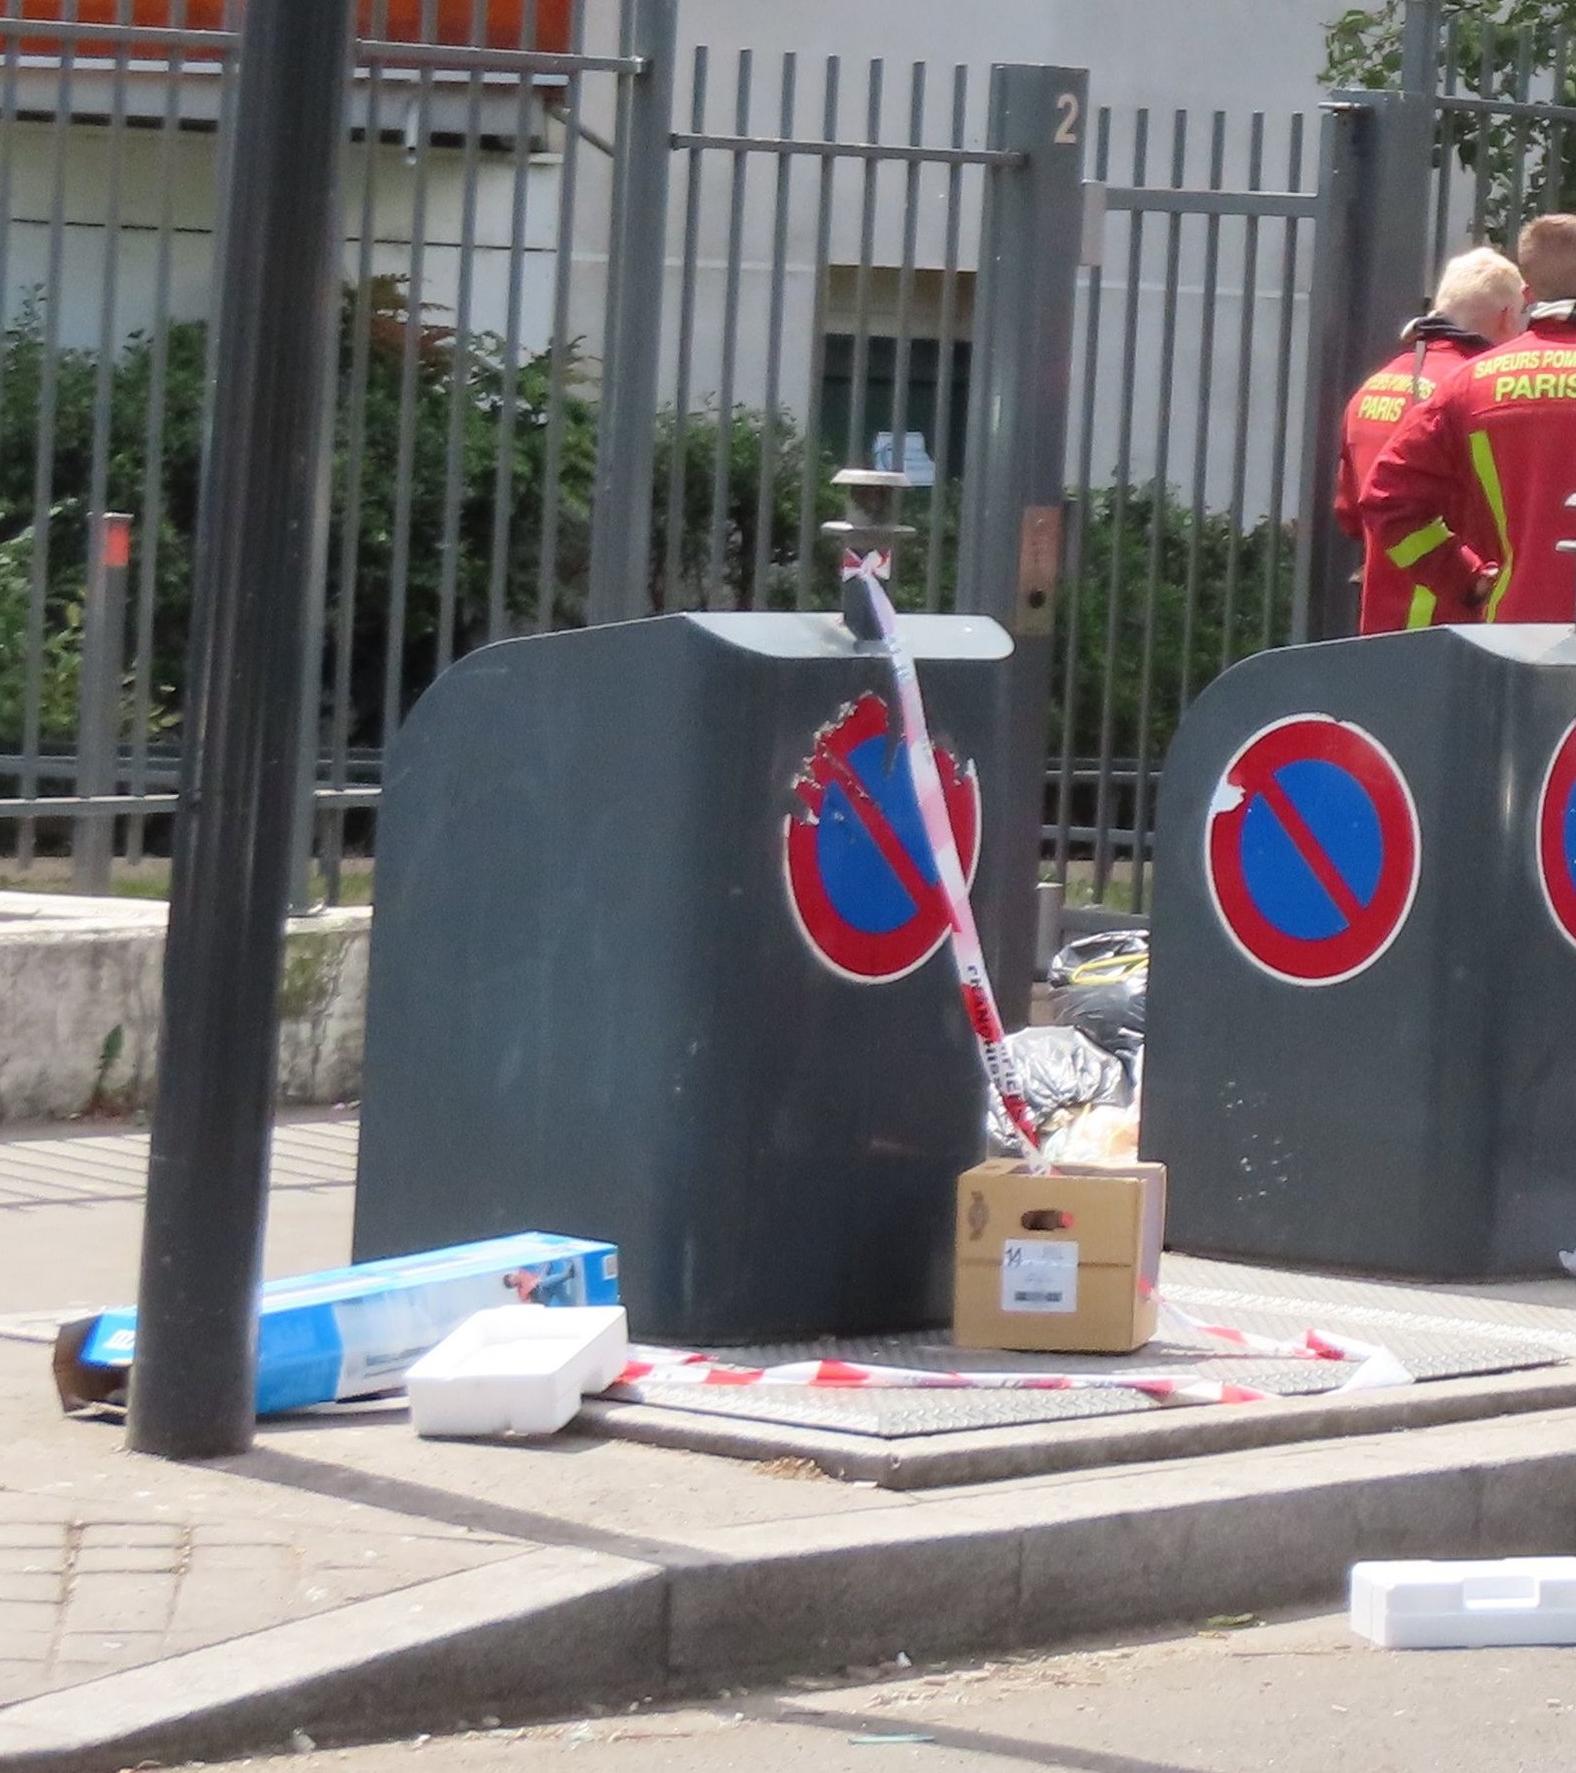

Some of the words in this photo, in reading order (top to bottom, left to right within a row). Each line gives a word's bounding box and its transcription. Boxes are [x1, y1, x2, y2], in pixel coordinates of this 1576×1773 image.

[1054, 93, 1079, 144] 2
[1474, 351, 1540, 379] SAPEURS
[1357, 394, 1407, 423] PARIS
